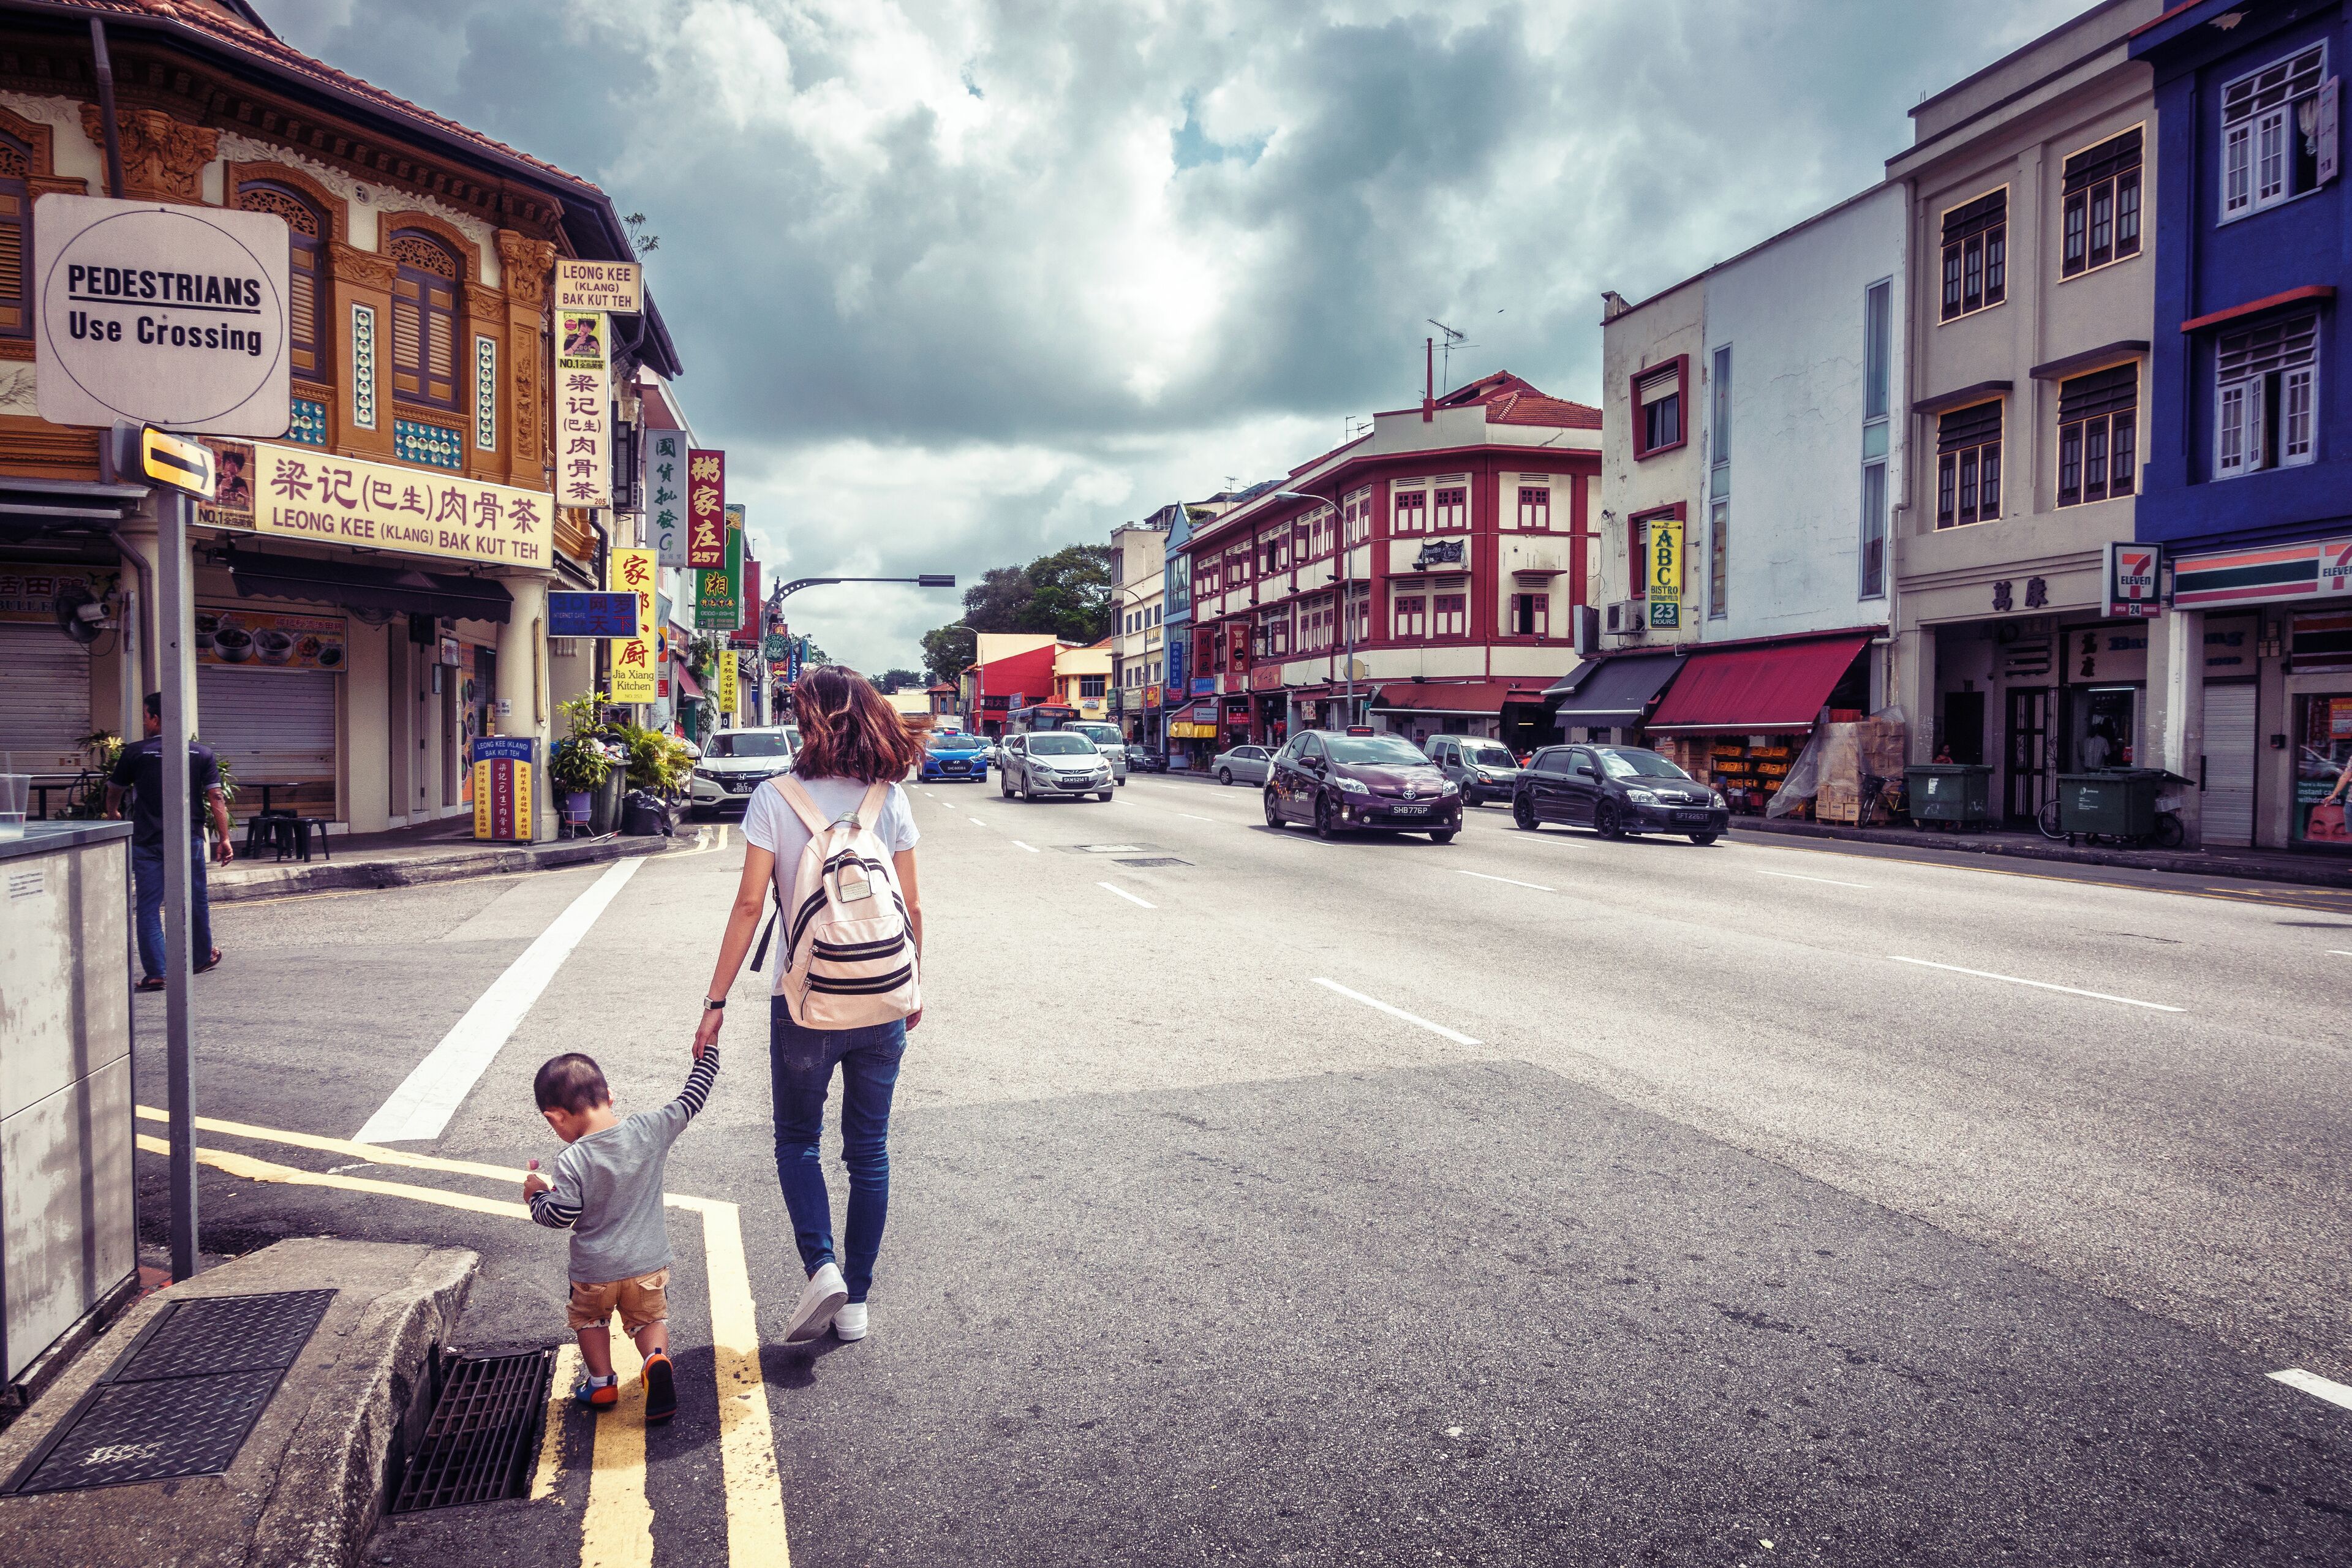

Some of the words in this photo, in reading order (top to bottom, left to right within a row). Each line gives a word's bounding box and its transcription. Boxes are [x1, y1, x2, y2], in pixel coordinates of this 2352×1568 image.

[564, 265, 603, 279] LEONG
[608, 268, 631, 282] KEE
[69, 265, 261, 307] PEDESTRIANS
[575, 281, 620, 293] (KLANG)
[563, 293, 584, 305] BAK
[588, 294, 608, 306] KUT
[612, 295, 631, 307] TEH
[69, 311, 122, 342] Use
[137, 316, 262, 357] Crossing
[559, 358, 579, 369] NO.1
[564, 374, 601, 500] 梁记(巴生)肉骨茶
[654, 437, 679, 530] 國貨批發
[270, 458, 541, 534] 梁记(巴生)肉骨茶
[690, 455, 722, 551] 粥家庄
[198, 508, 223, 525] NO.1
[273, 507, 334, 533] LEONG
[341, 516, 375, 540] KEE
[381, 522, 434, 546] (KLANG)
[439, 530, 470, 551] BAK
[476, 535, 506, 556] KUT
[511, 540, 539, 560] TEH
[692, 551, 721, 563] 257
[2122, 553, 2151, 599] 7
[1651, 585, 1678, 595] BISTRO
[619, 554, 650, 669] 家厨
[1654, 604, 1675, 619] 23
[2130, 605, 2141, 615] 24
[612, 669, 625, 679] Jia
[628, 669, 655, 681] Xiang
[617, 680, 651, 691] Kitchen
[477, 741, 494, 750] LEONG
[507, 741, 529, 751] (KLANG)
